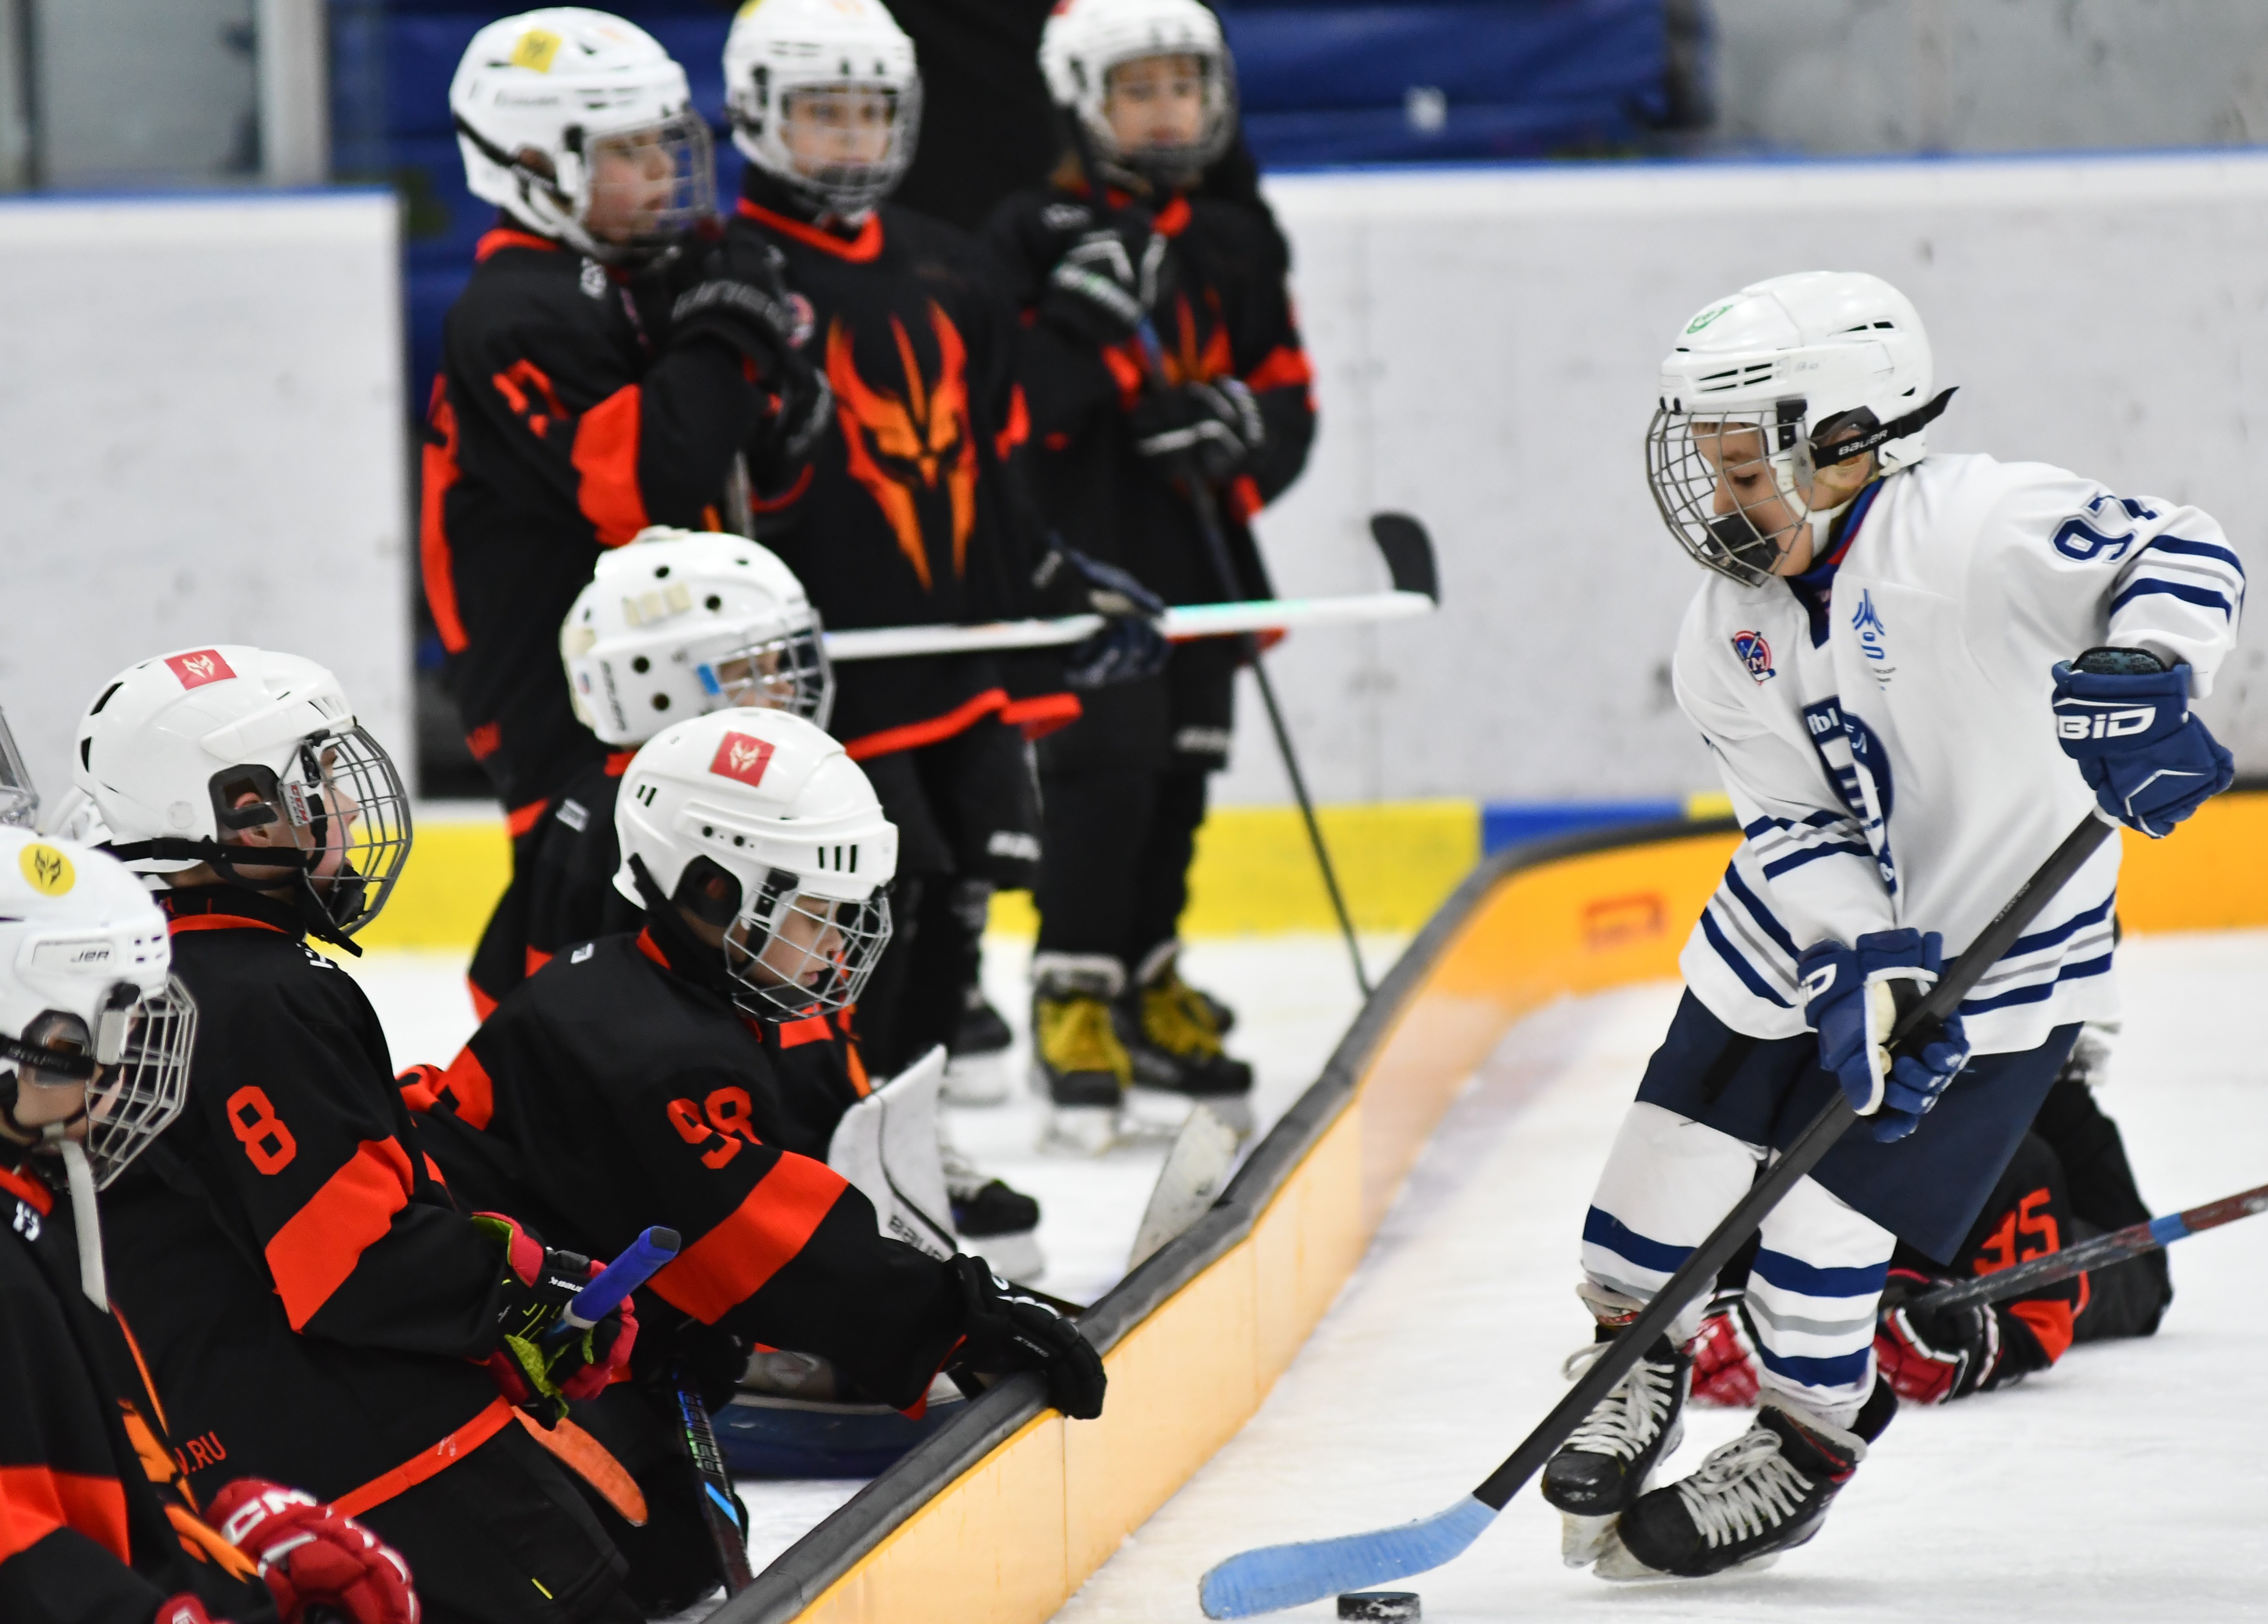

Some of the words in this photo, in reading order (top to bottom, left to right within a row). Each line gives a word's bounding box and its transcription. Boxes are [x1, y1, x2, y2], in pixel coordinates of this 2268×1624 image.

[290, 784, 309, 822] CCM
[227, 1085, 296, 1175] 8
[666, 1085, 763, 1169] 98
